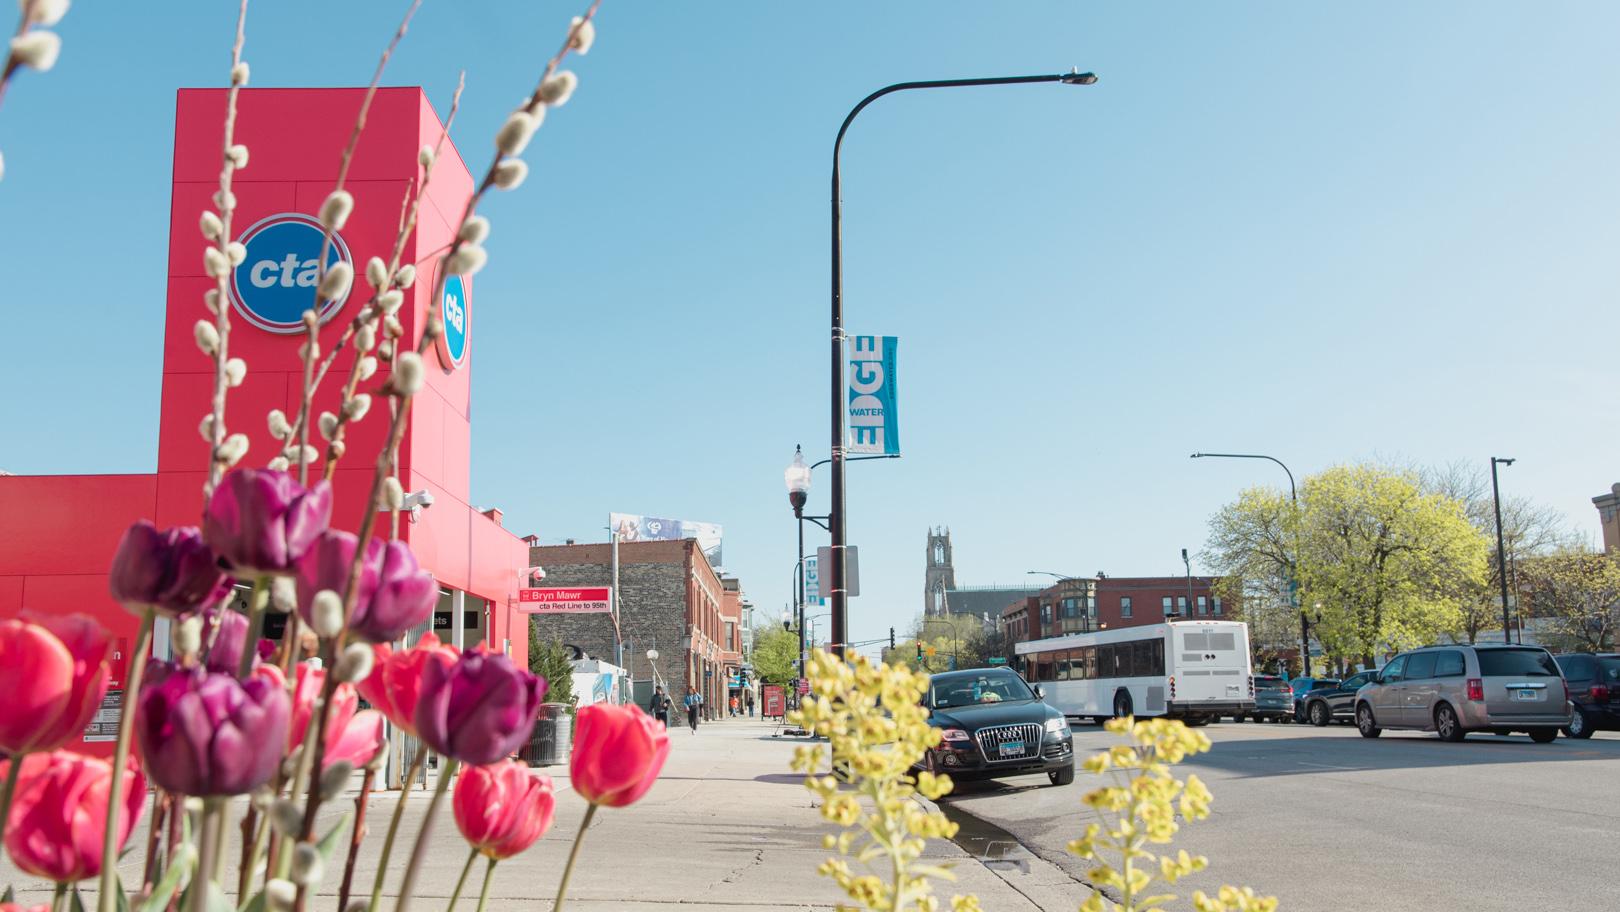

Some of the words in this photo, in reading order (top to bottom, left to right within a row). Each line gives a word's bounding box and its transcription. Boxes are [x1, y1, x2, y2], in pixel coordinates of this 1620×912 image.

[250, 253, 327, 288] cta
[445, 293, 464, 335] cta
[849, 336, 885, 454] EDGE
[849, 407, 884, 417] WATER
[532, 591, 554, 601] Bryn
[557, 591, 581, 599] Mawr
